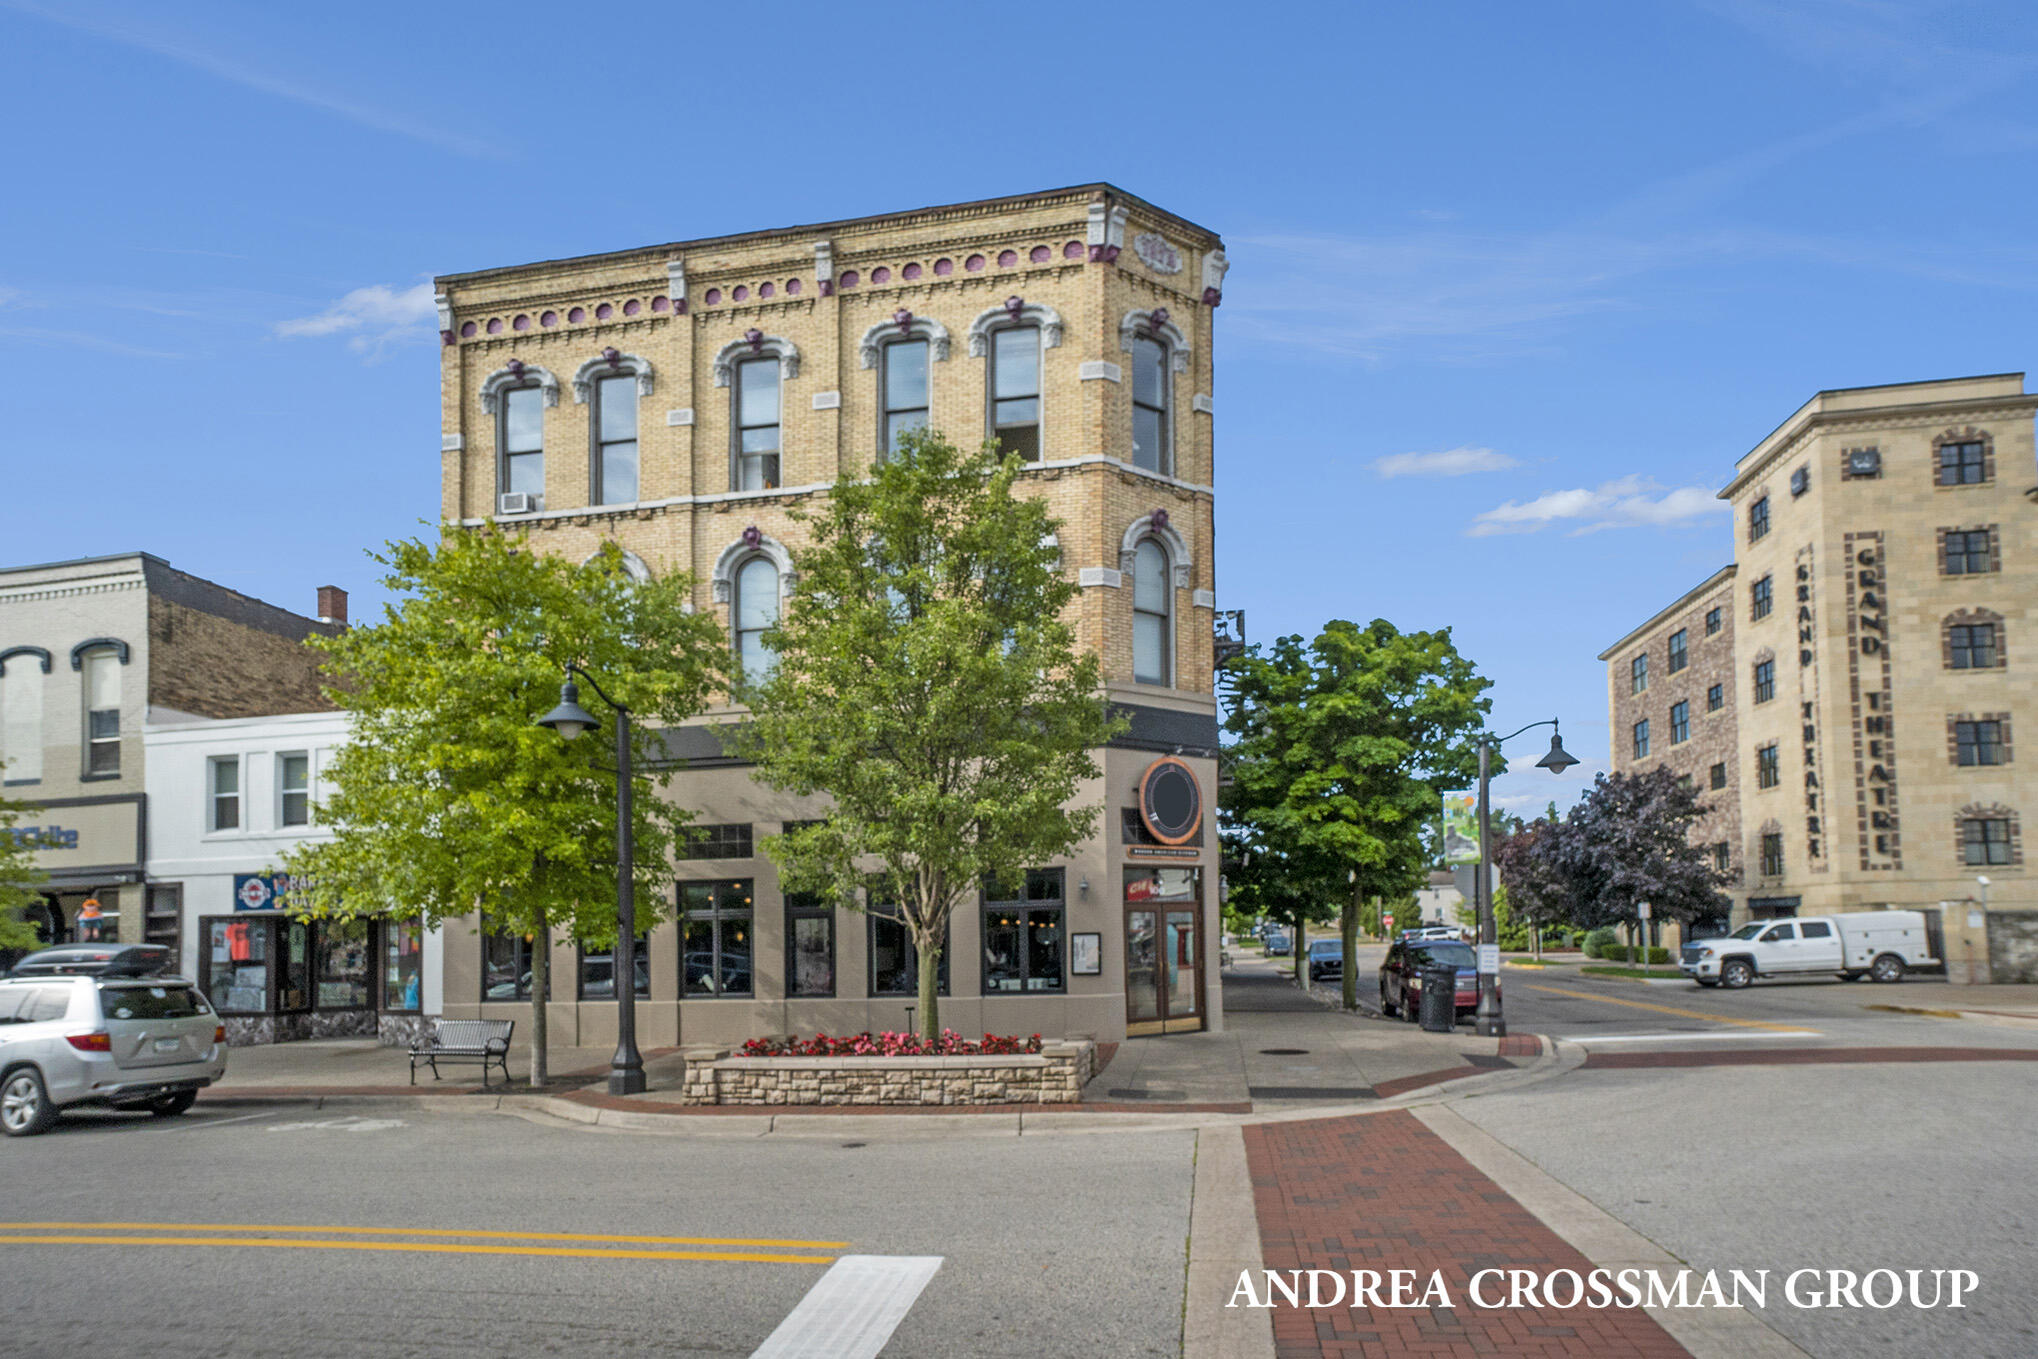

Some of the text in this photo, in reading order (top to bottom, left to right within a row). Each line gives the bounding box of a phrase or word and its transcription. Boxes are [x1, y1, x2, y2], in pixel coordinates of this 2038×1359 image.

[1797, 563, 1821, 858] GRAND THEATRE
[1858, 548, 1893, 854] GRAND THEATRE
